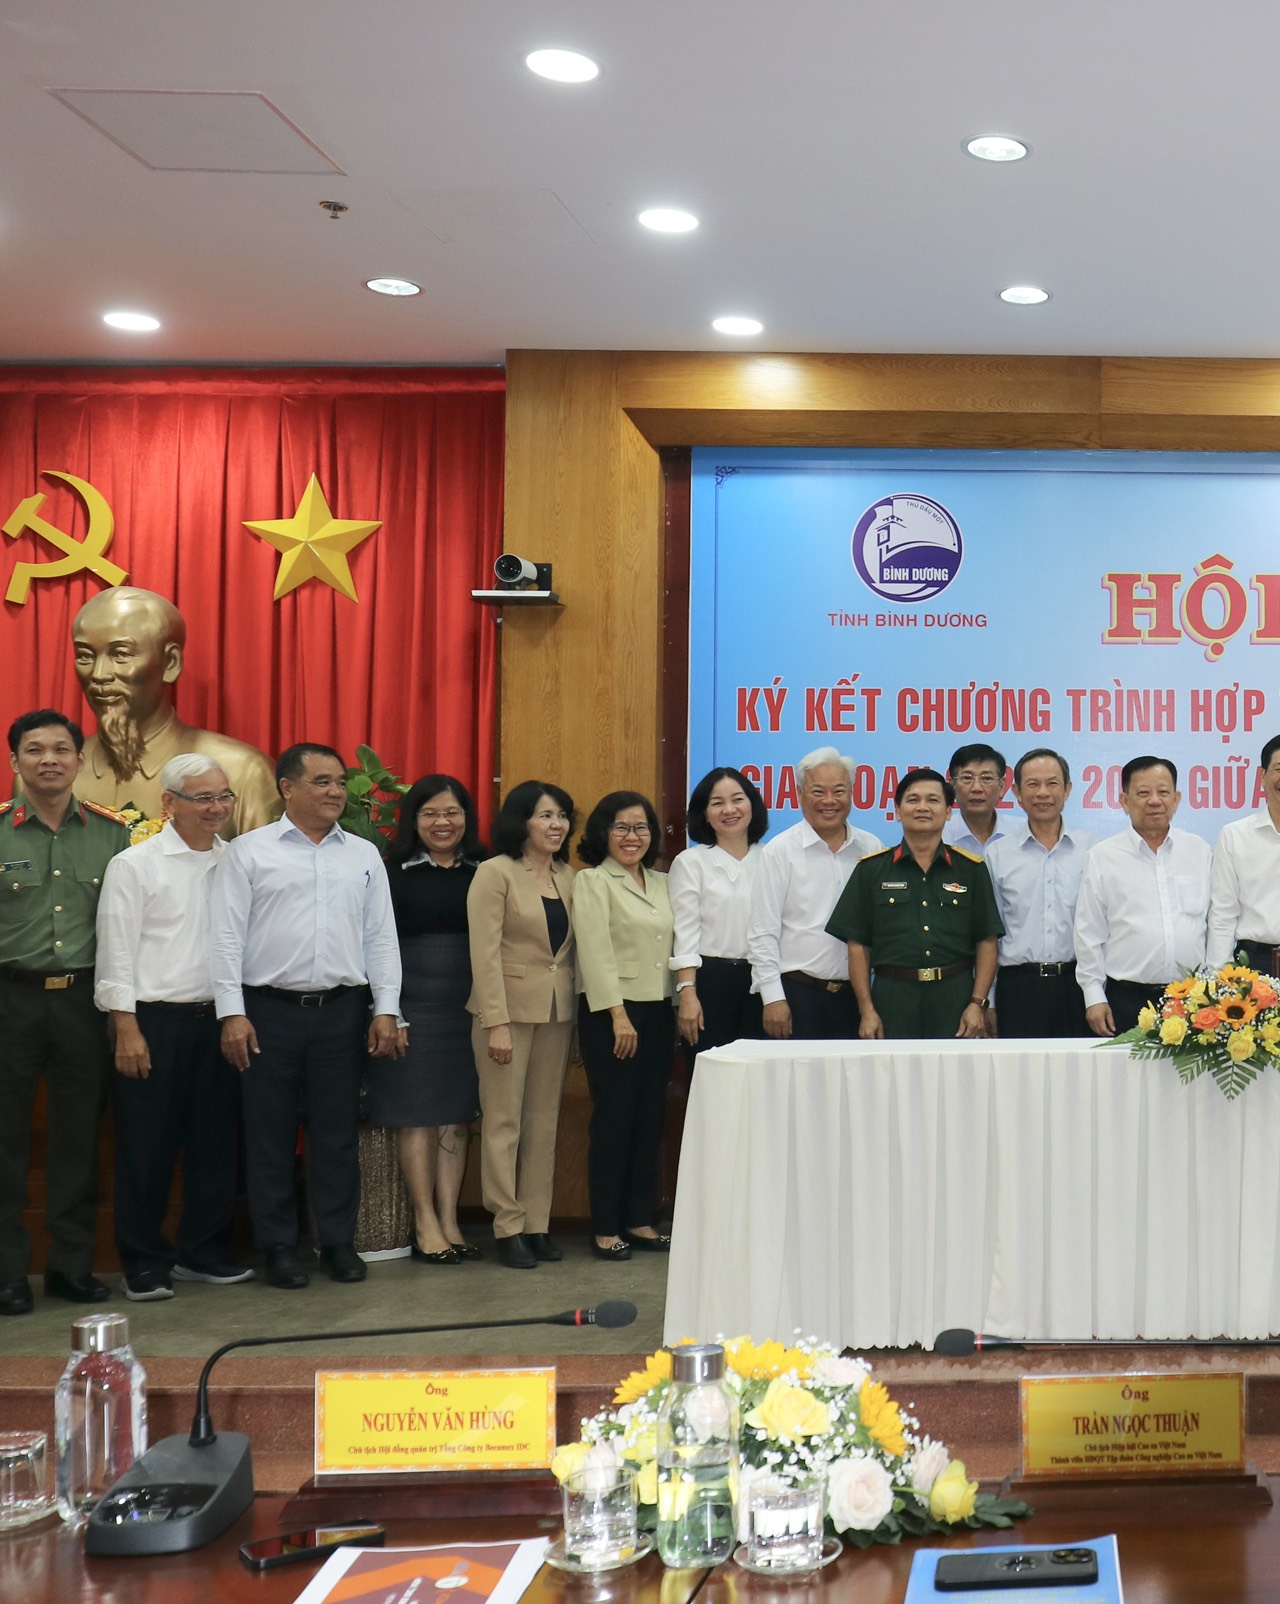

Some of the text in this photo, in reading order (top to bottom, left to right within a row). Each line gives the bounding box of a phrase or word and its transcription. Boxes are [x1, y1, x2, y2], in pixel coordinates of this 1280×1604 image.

[883, 565, 949, 581] BÌNH DƯƠNG
[828, 609, 987, 627] TỈNH BÌNH DƯƠNG
[737, 677, 787, 732] KÝ
[805, 673, 881, 732] KẾT
[900, 682, 1051, 733] CHƯƠNG
[1067, 679, 1175, 732] TRÌNH
[1191, 682, 1265, 743] HỢP
[740, 764, 799, 809] GIA
[425, 1383, 448, 1397] Ông
[1121, 1385, 1150, 1402] Ông
[362, 1406, 514, 1433] NGUYỄN VĂN HÙNG
[1073, 1410, 1200, 1438] TRẦN NGỌC THUẬN
